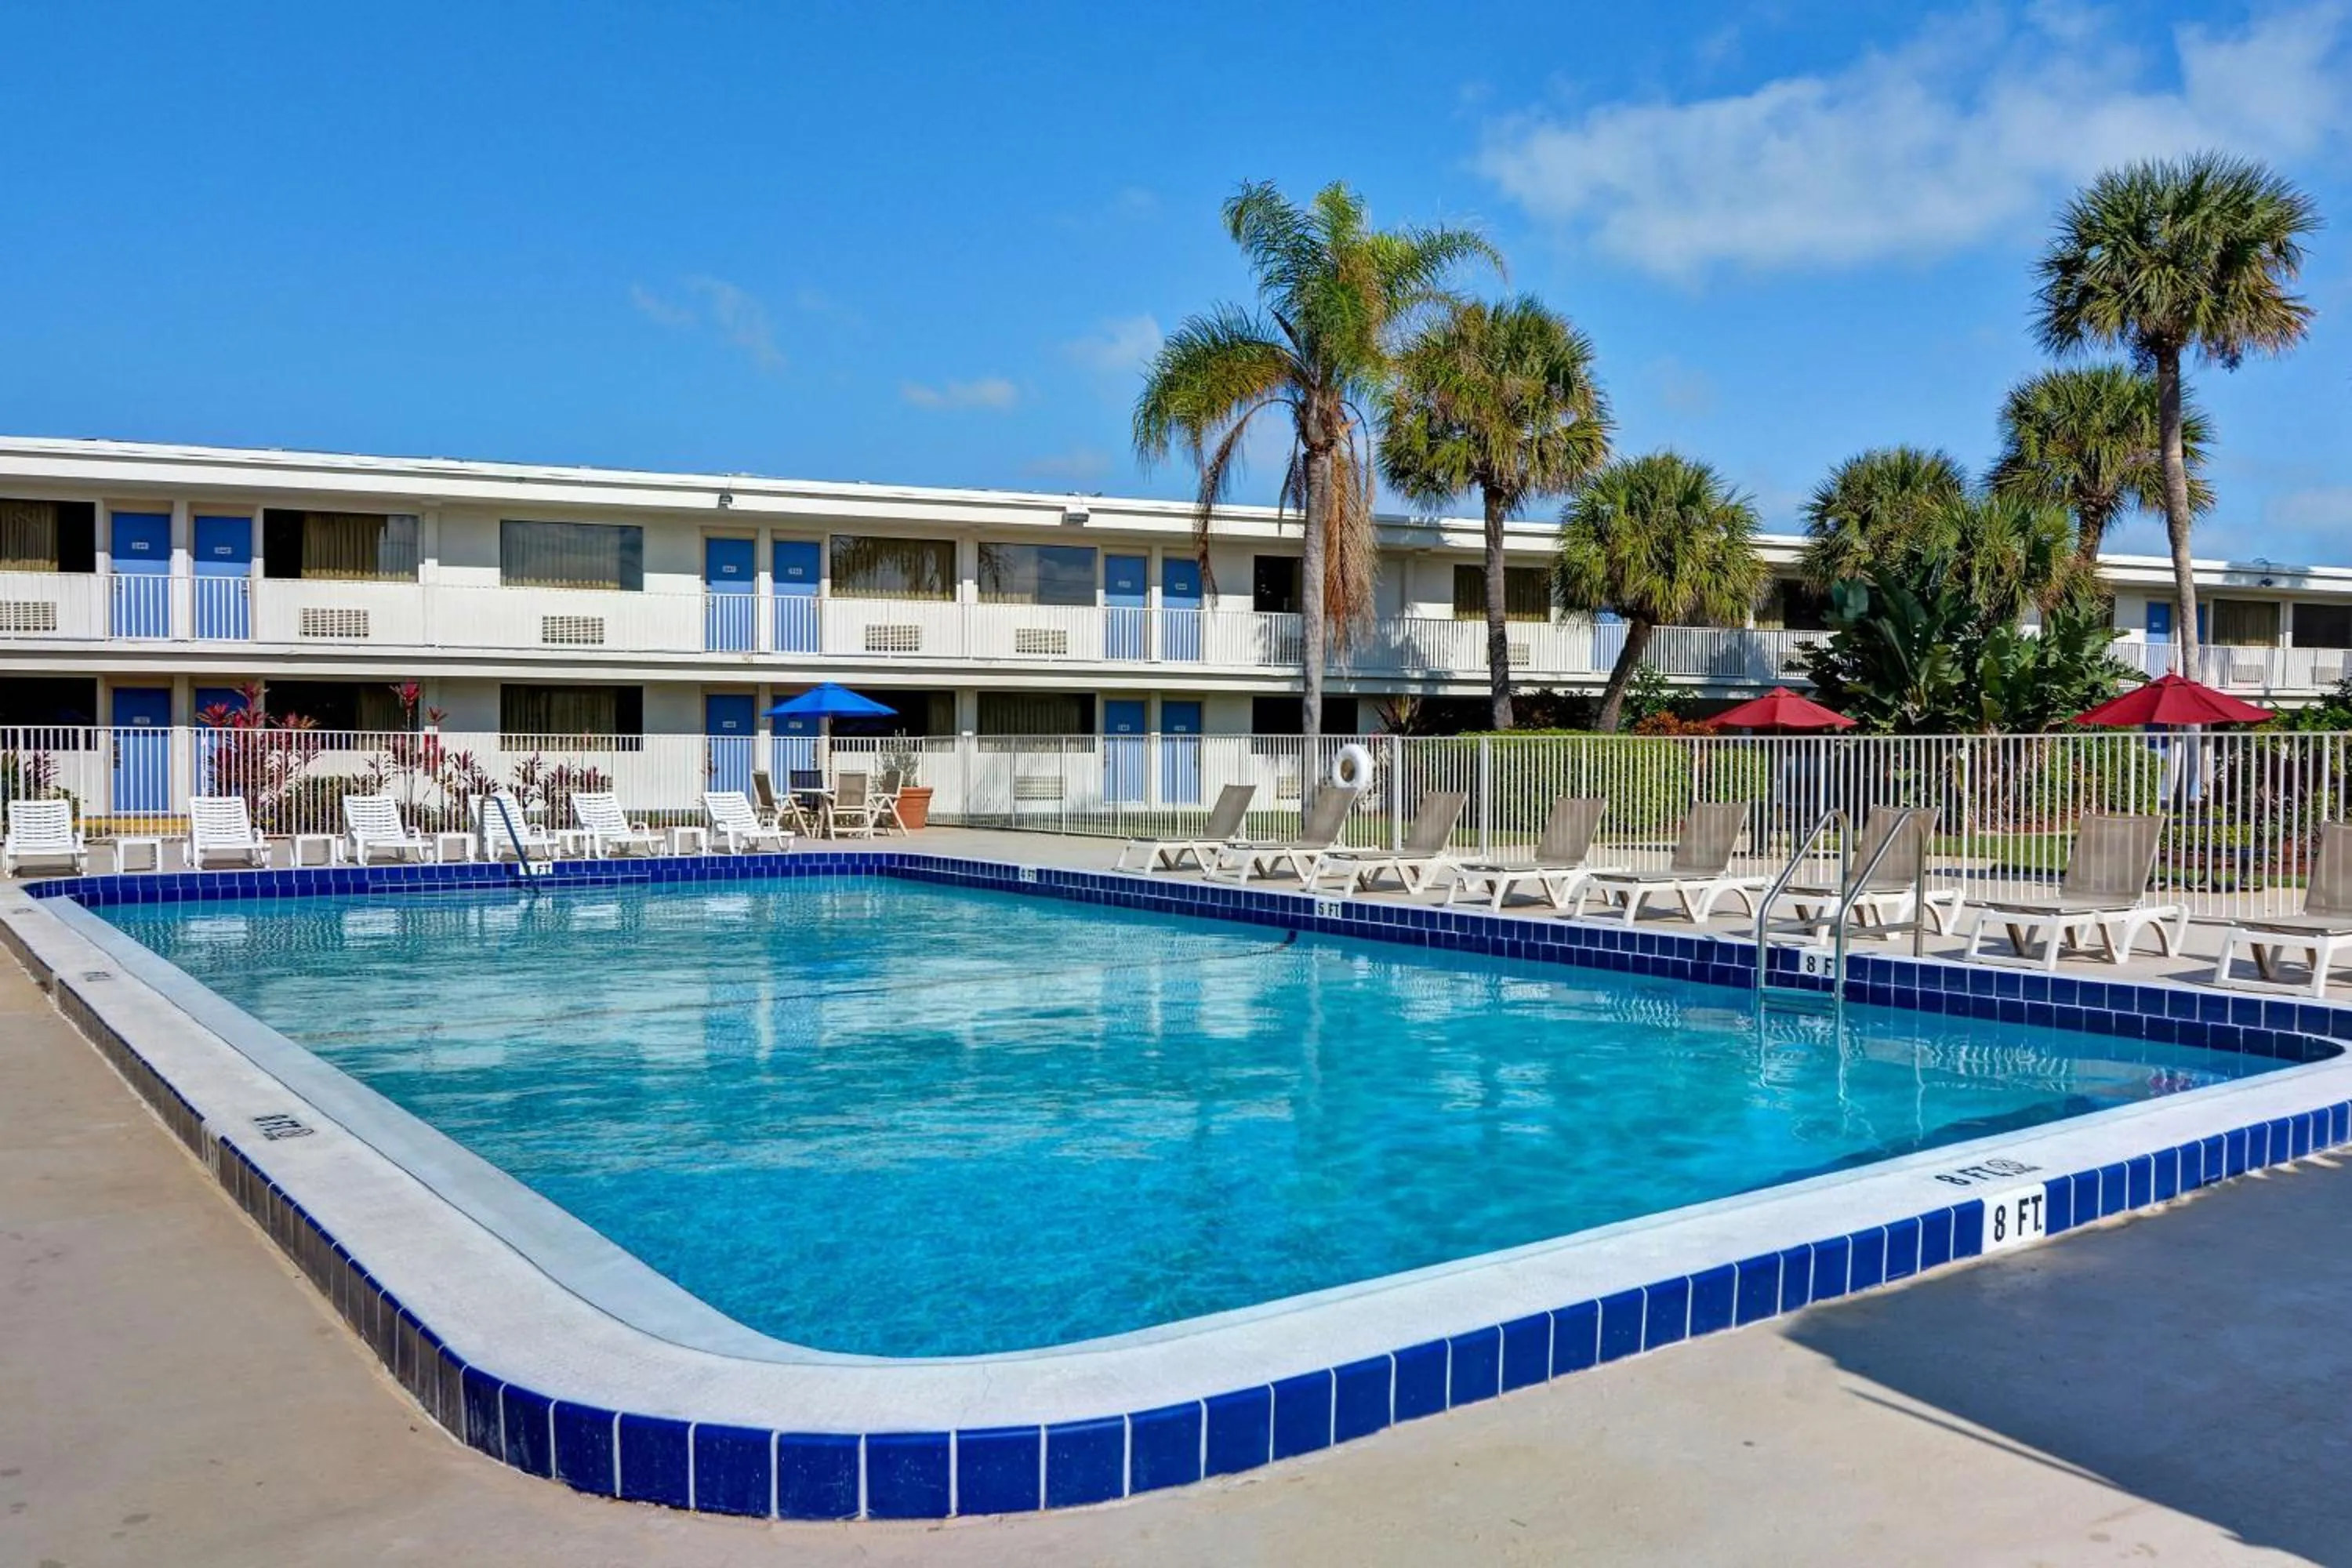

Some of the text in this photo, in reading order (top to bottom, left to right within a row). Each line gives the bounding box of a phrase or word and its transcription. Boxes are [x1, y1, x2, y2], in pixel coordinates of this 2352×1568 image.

[538, 864, 550, 875] FT
[1318, 902, 1339, 917] 5 FT
[1807, 956, 1836, 975] 8 F
[1934, 1175, 1972, 1185] 8
[1956, 1166, 2016, 1181] FT
[1994, 1205, 2005, 1242] 8
